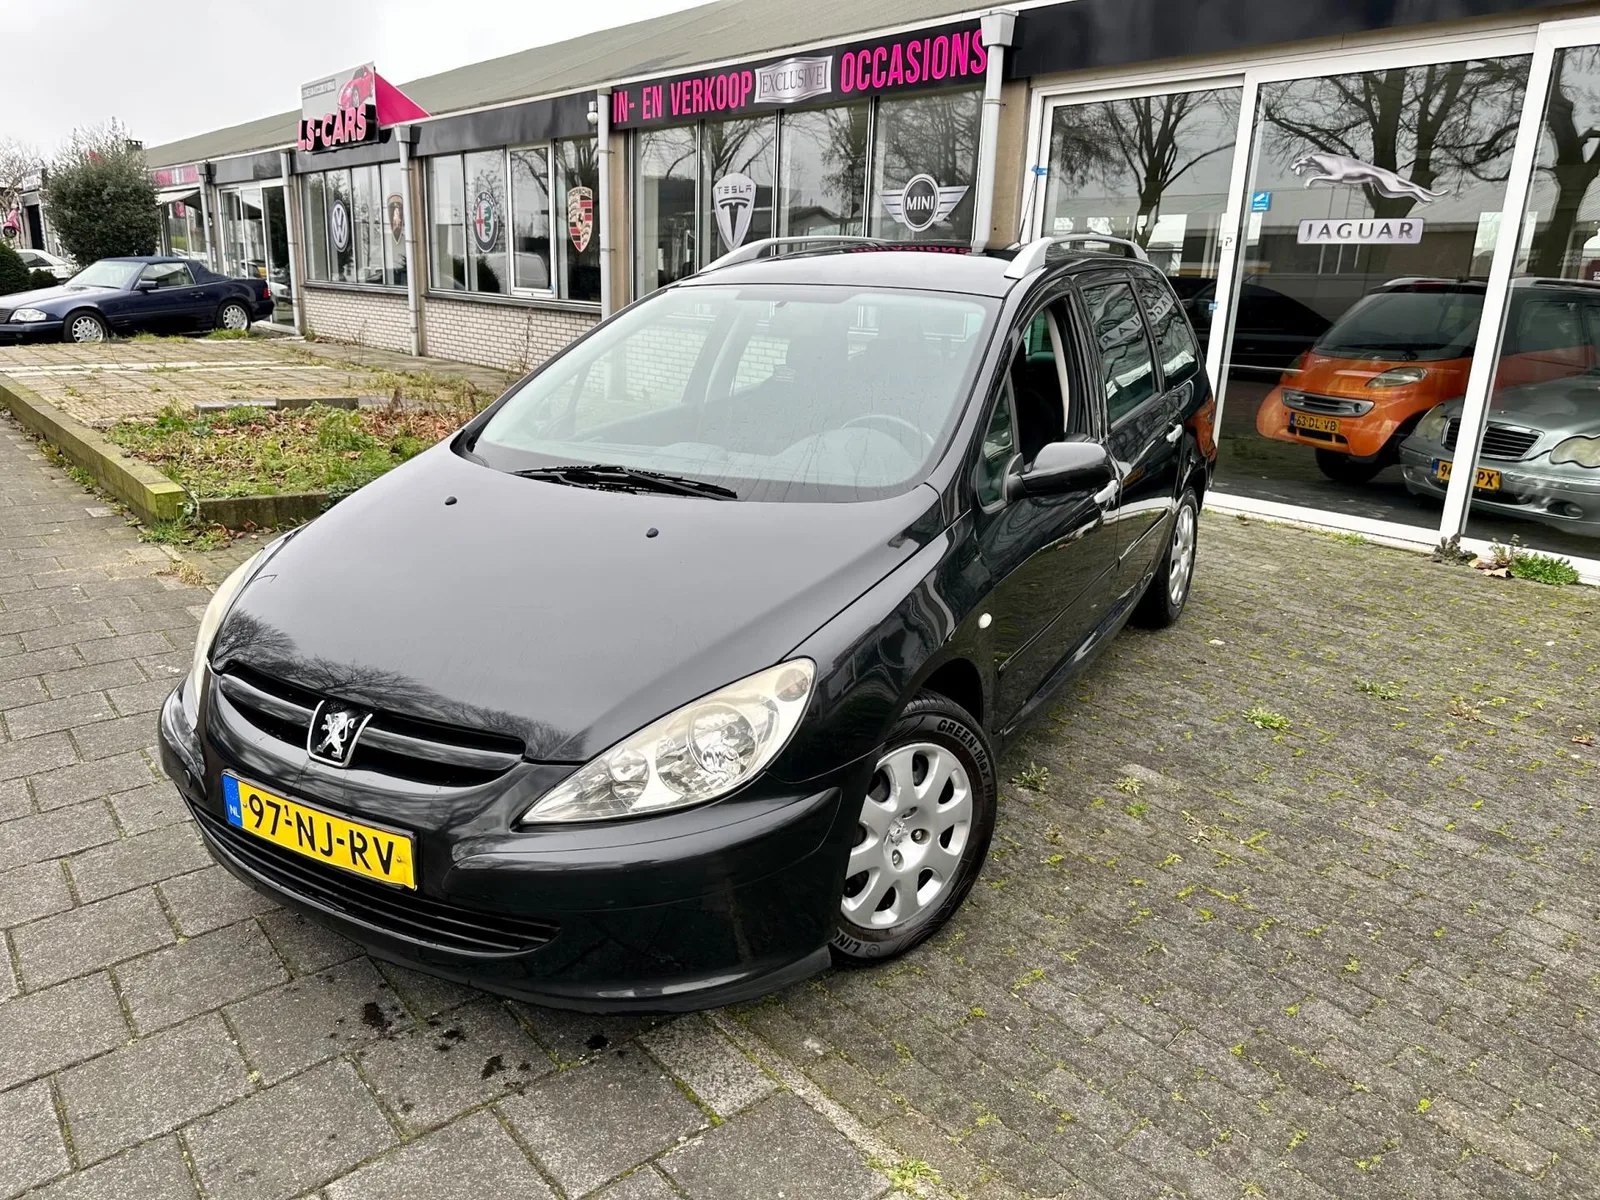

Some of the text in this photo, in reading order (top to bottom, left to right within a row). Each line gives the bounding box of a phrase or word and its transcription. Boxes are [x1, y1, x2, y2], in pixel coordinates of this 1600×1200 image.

[613, 28, 987, 123] IN- EN VERKOOP EXCLUSIVE OCCASIONS
[297, 103, 367, 151] LS-CARS
[717, 184, 751, 194] TESLA
[906, 195, 934, 210] MINI
[1304, 222, 1414, 242] JAGUAR
[230, 804, 241, 818] NL
[249, 794, 394, 875] 97-NJ-RV
